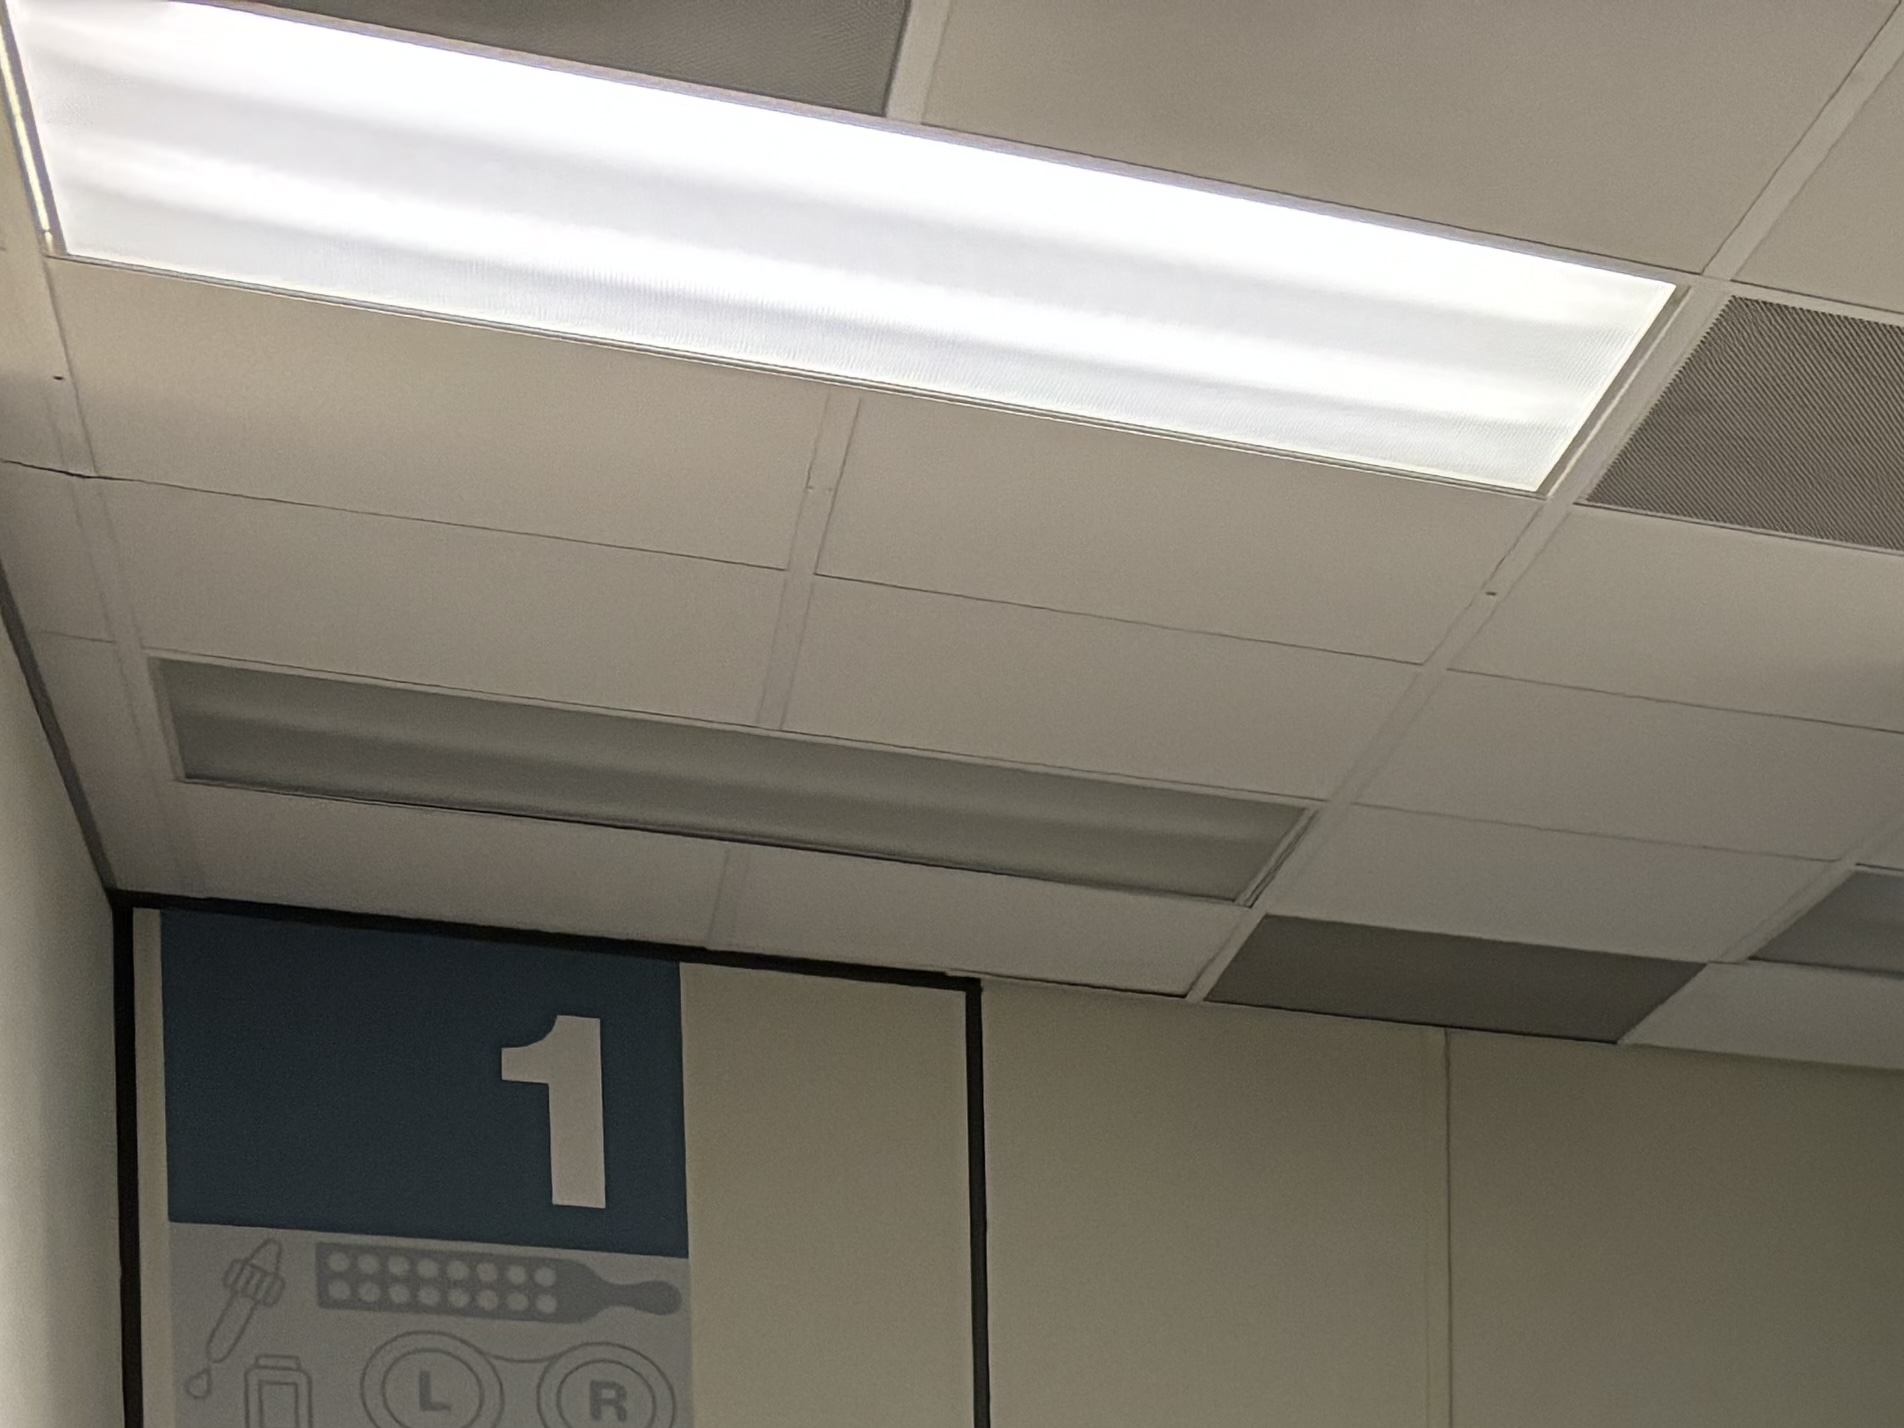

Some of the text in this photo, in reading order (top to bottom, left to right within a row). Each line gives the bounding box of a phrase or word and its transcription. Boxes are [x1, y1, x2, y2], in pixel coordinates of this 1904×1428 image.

[501, 1014, 606, 1209] 1
[418, 1370, 452, 1412] L
[589, 1380, 629, 1423] R
